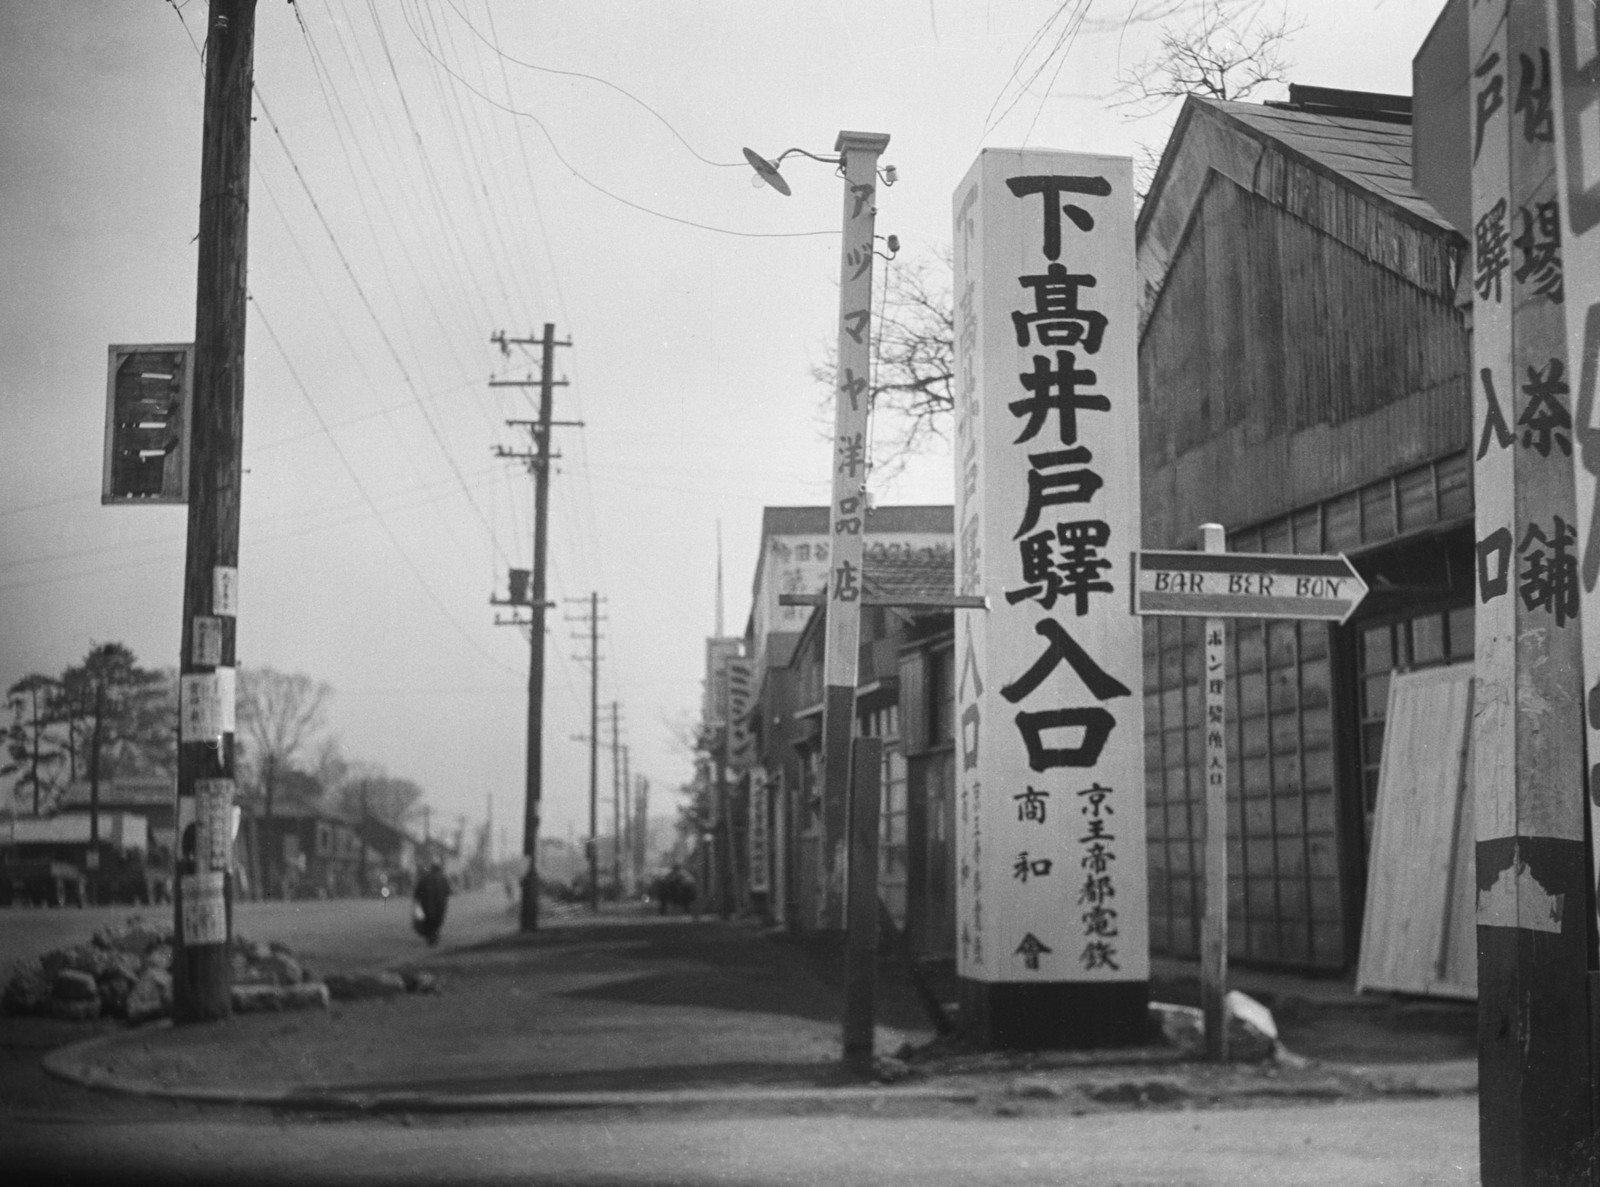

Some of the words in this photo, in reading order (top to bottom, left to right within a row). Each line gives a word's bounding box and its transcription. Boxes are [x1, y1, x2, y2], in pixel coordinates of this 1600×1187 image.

[834, 183, 874, 602] アヅマヤ洋品店
[1473, 0, 1516, 604] 戸驛入口
[1154, 571, 1204, 592] BAR
[1228, 574, 1274, 596] BER
[1013, 785, 1053, 971] 商和會
[1077, 782, 1119, 971] 京王帝都電鉄
